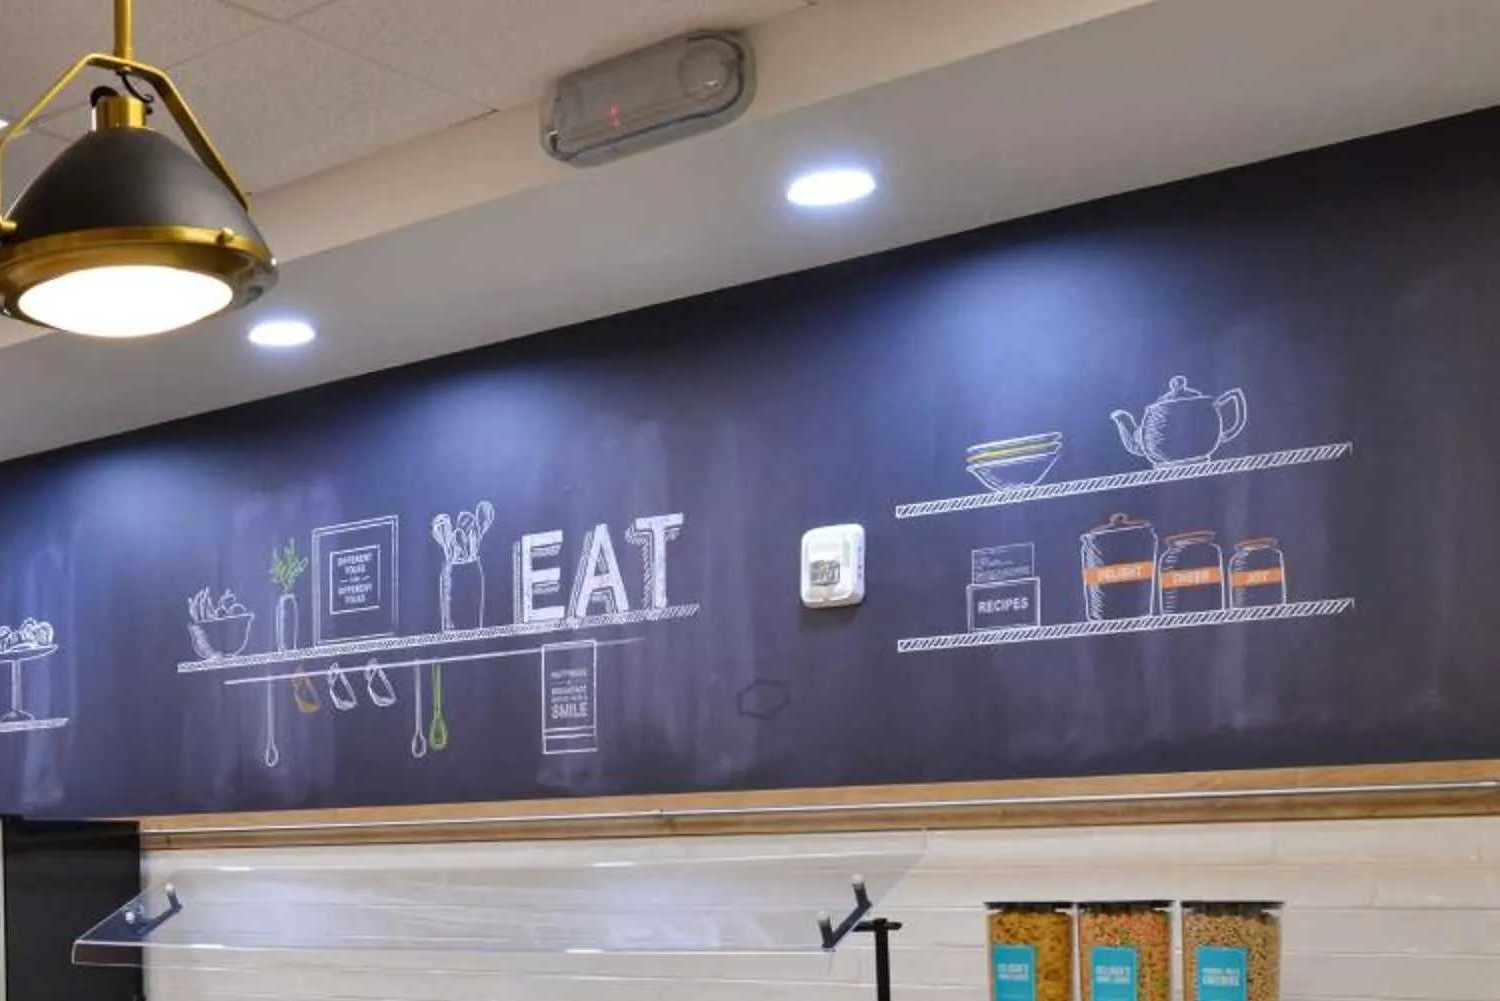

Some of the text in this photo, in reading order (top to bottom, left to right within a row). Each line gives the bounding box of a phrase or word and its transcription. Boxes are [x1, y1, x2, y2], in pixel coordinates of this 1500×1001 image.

[514, 512, 684, 622] EAT
[977, 597, 1029, 613] RECIPES
[551, 702, 587, 719] SMILE
